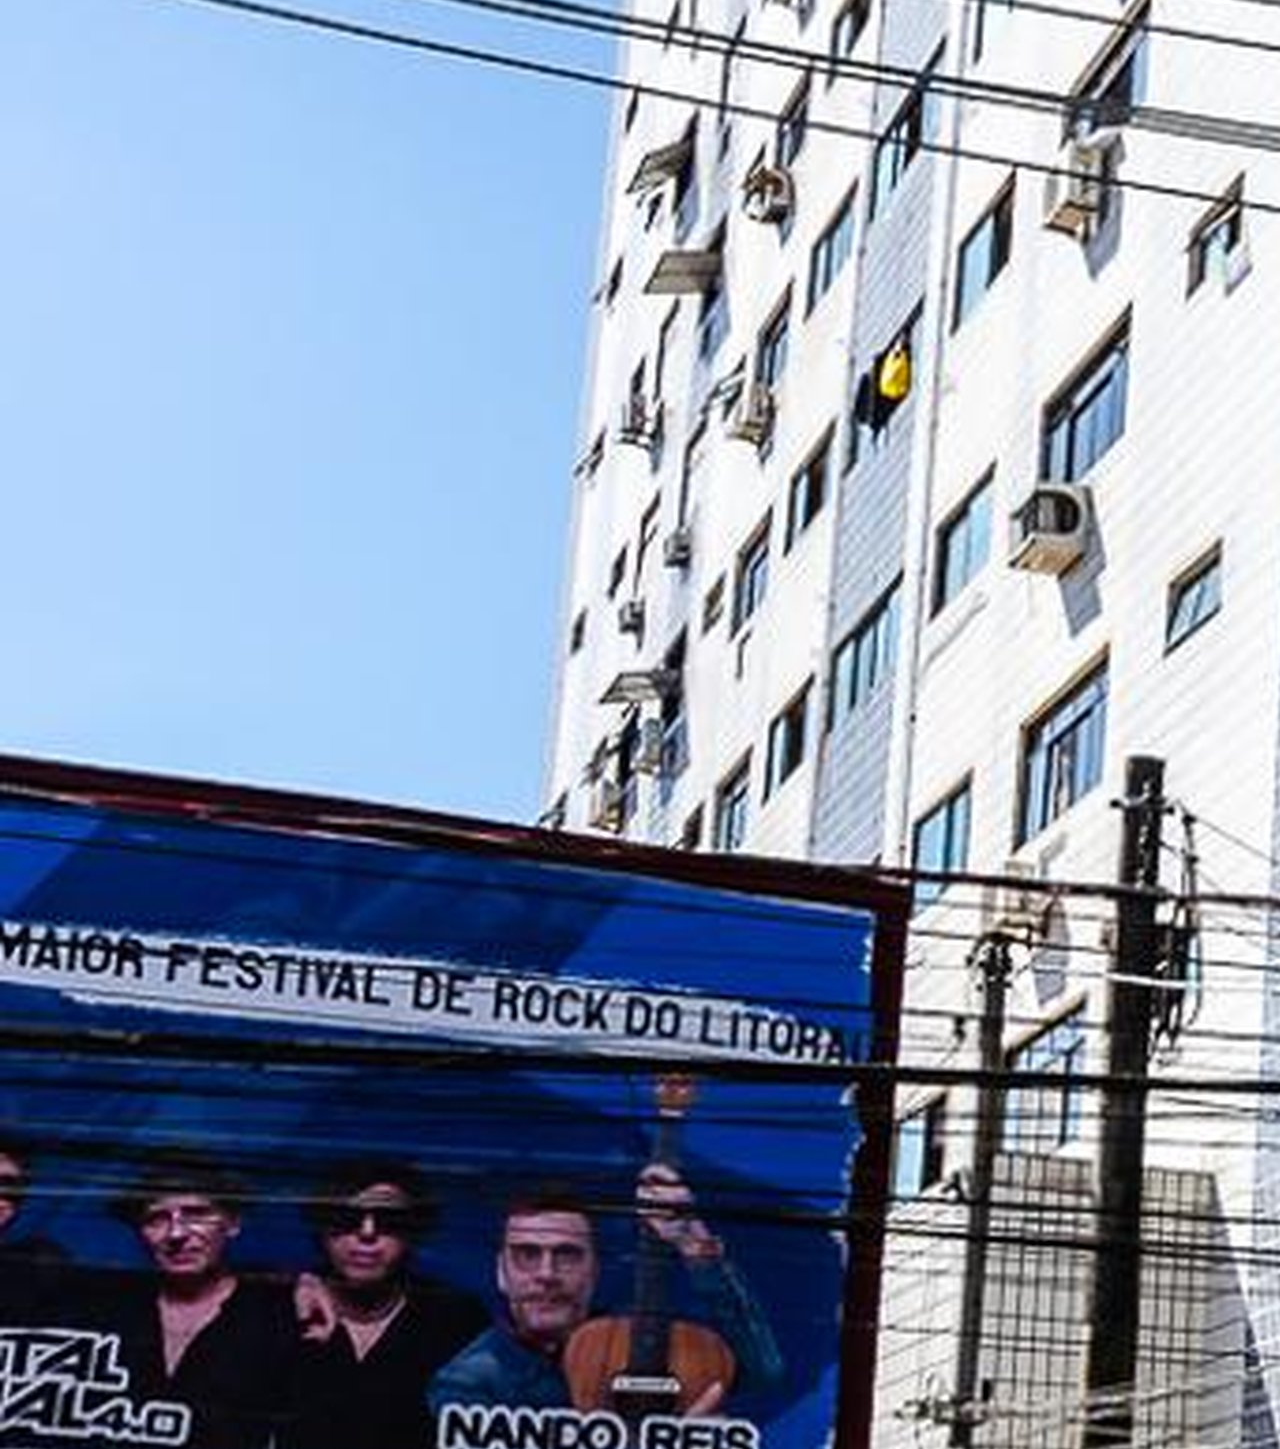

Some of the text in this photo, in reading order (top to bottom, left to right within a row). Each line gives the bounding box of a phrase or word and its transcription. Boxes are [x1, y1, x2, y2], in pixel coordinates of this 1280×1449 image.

[0, 922, 145, 980] MAIOR
[166, 942, 391, 1007] FESTIVAL
[412, 965, 473, 1016] DE
[492, 979, 612, 1033] ROCK
[624, 993, 682, 1039] DO
